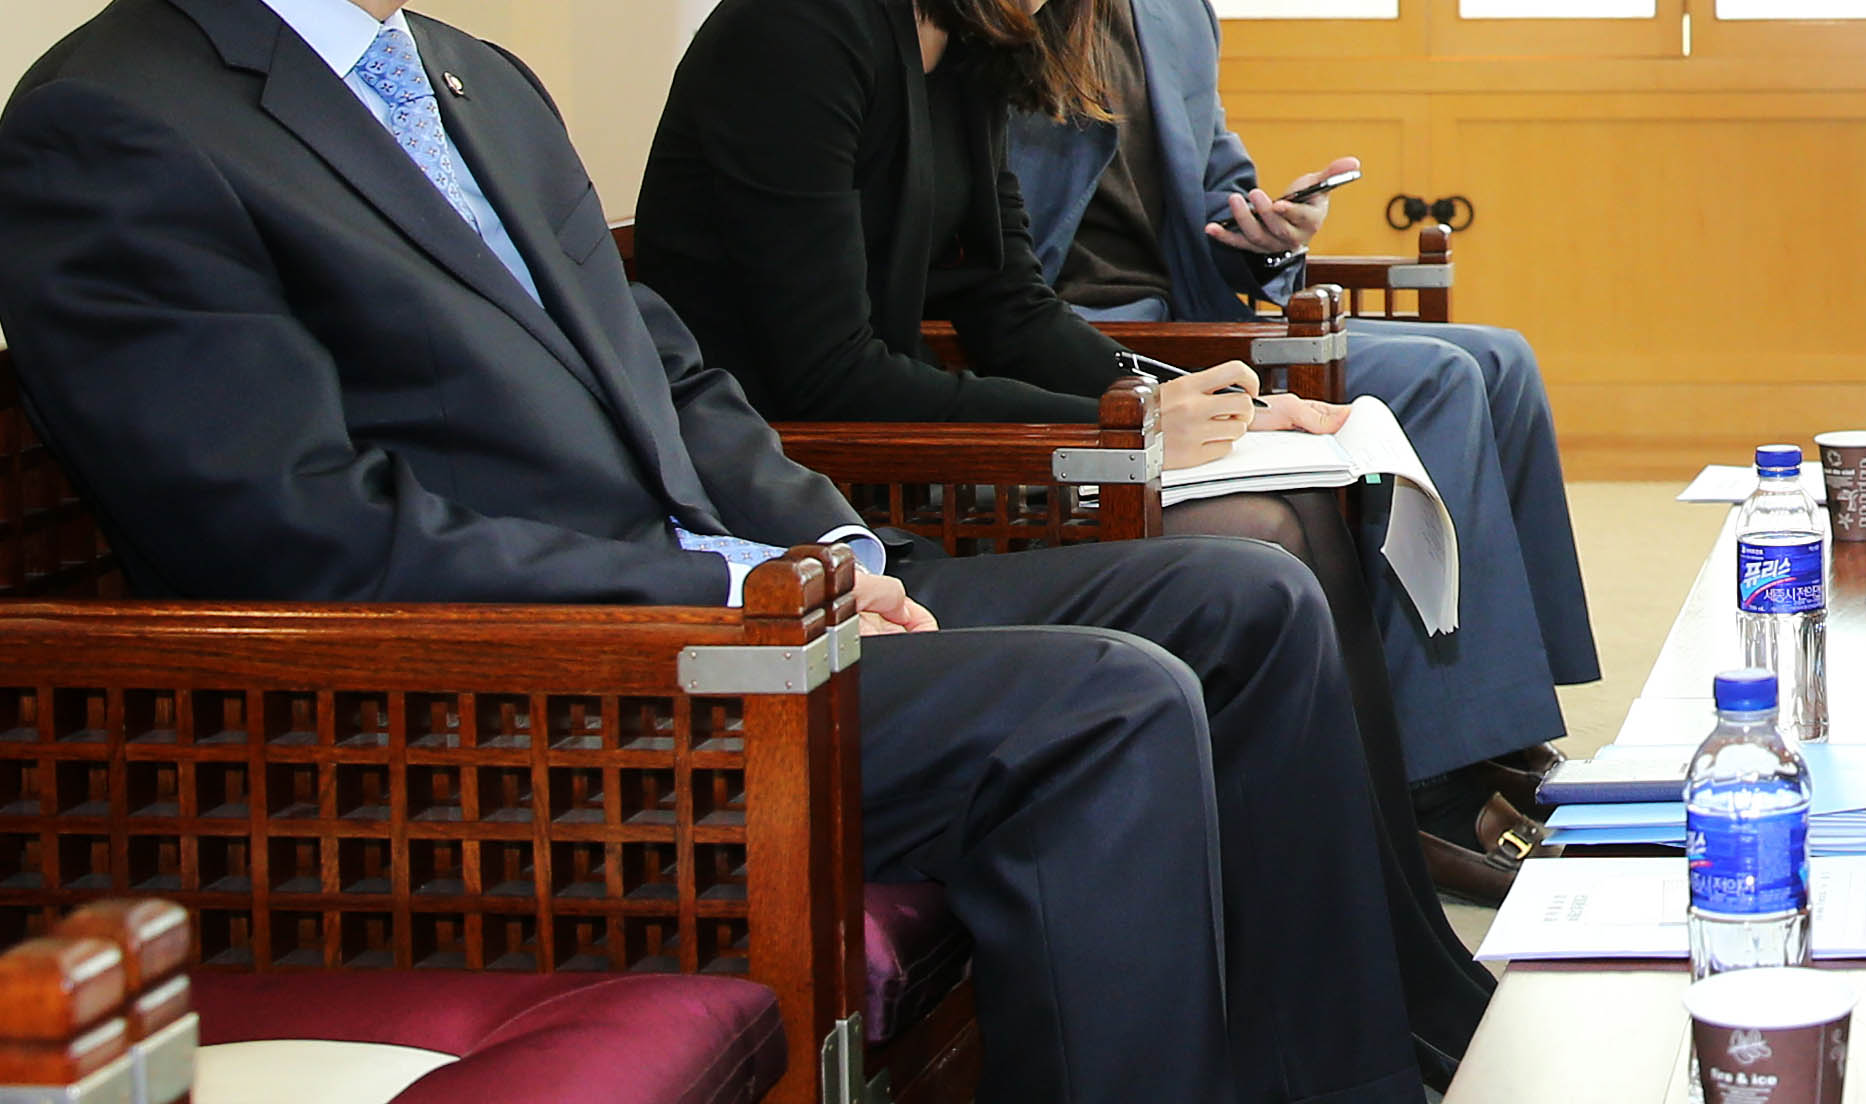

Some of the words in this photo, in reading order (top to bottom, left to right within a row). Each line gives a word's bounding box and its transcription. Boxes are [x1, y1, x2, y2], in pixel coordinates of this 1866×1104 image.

[1743, 557, 1791, 588] 퓨리스
[1735, 1072, 1748, 1084] &
[1751, 1073, 1778, 1086] ice
